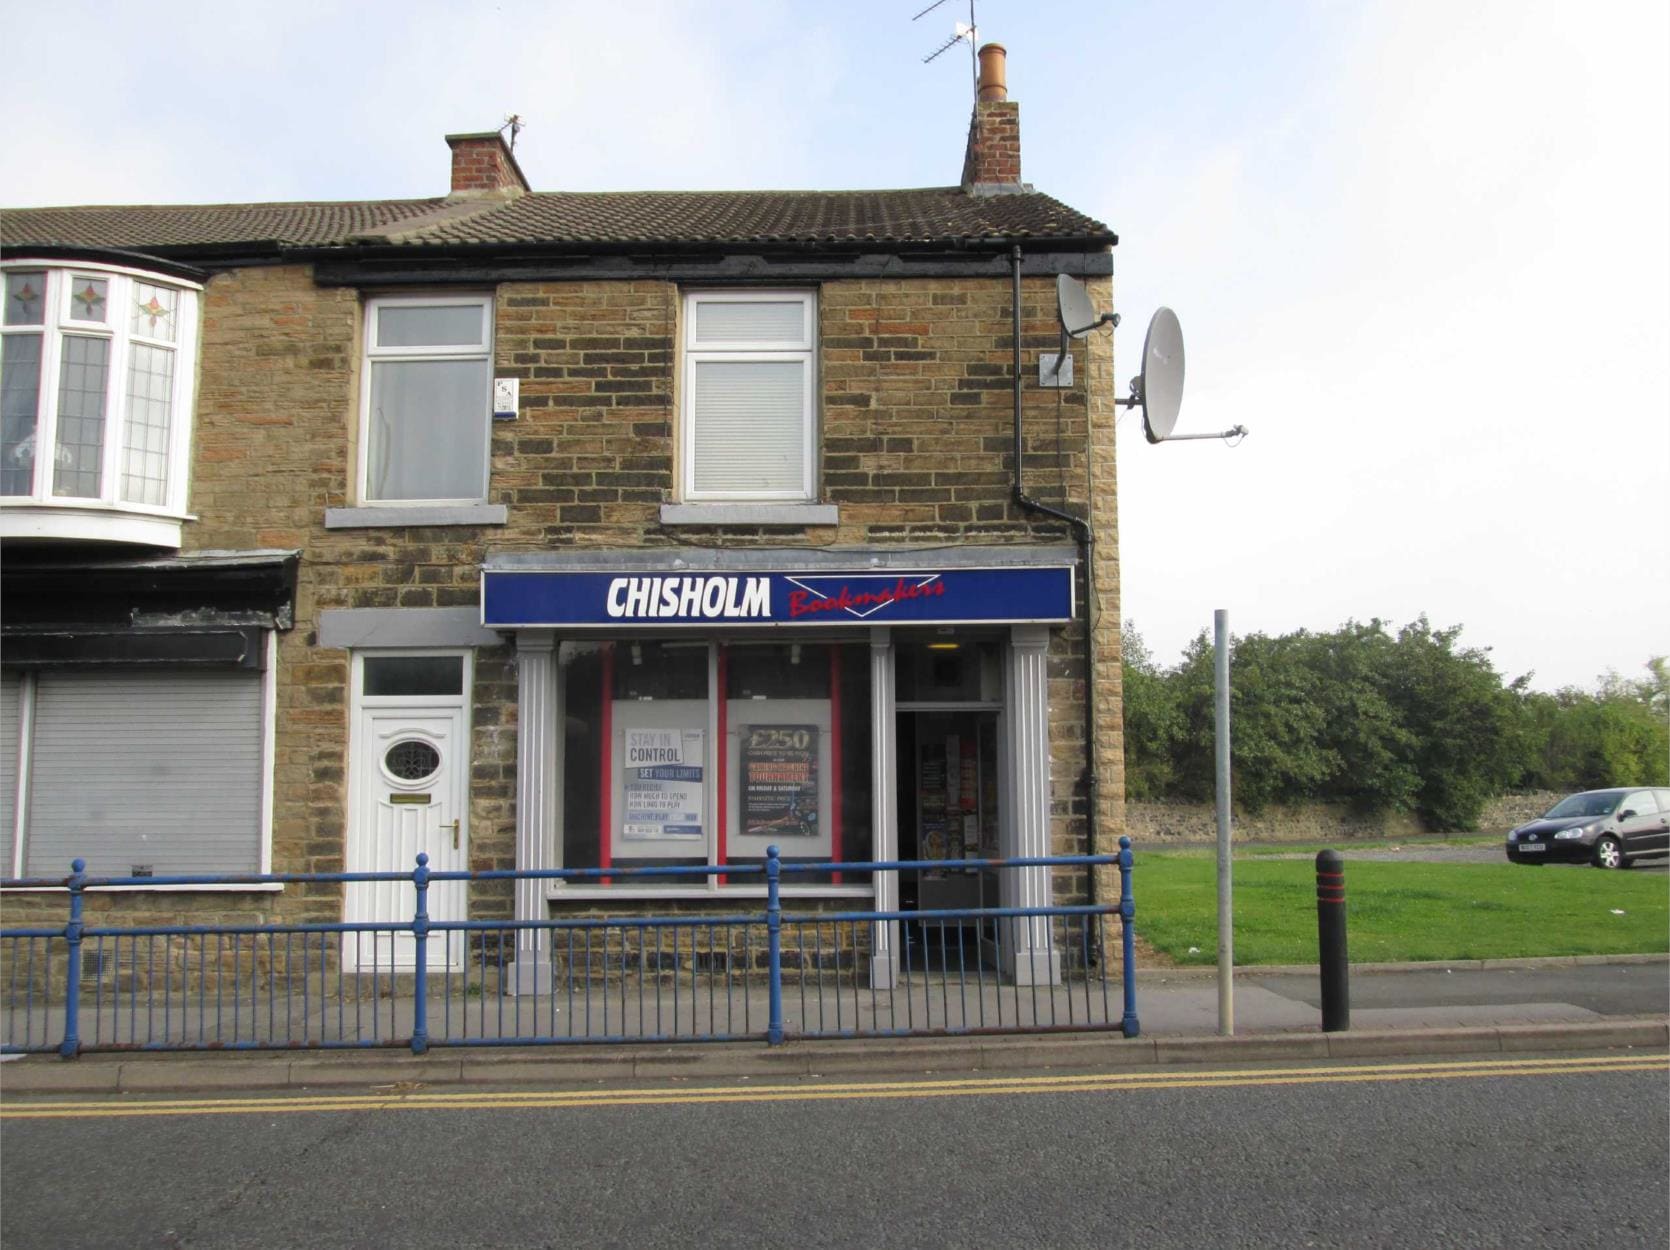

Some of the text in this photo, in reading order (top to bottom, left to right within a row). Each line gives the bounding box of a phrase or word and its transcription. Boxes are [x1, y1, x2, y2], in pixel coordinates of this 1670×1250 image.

[607, 577, 944, 617] CHISHOLM Bookmakers
[630, 733, 671, 746] STAY IN
[749, 730, 809, 750] £250
[630, 747, 680, 762] CONTROL
[640, 768, 700, 780] SET YOUR LIMITS
